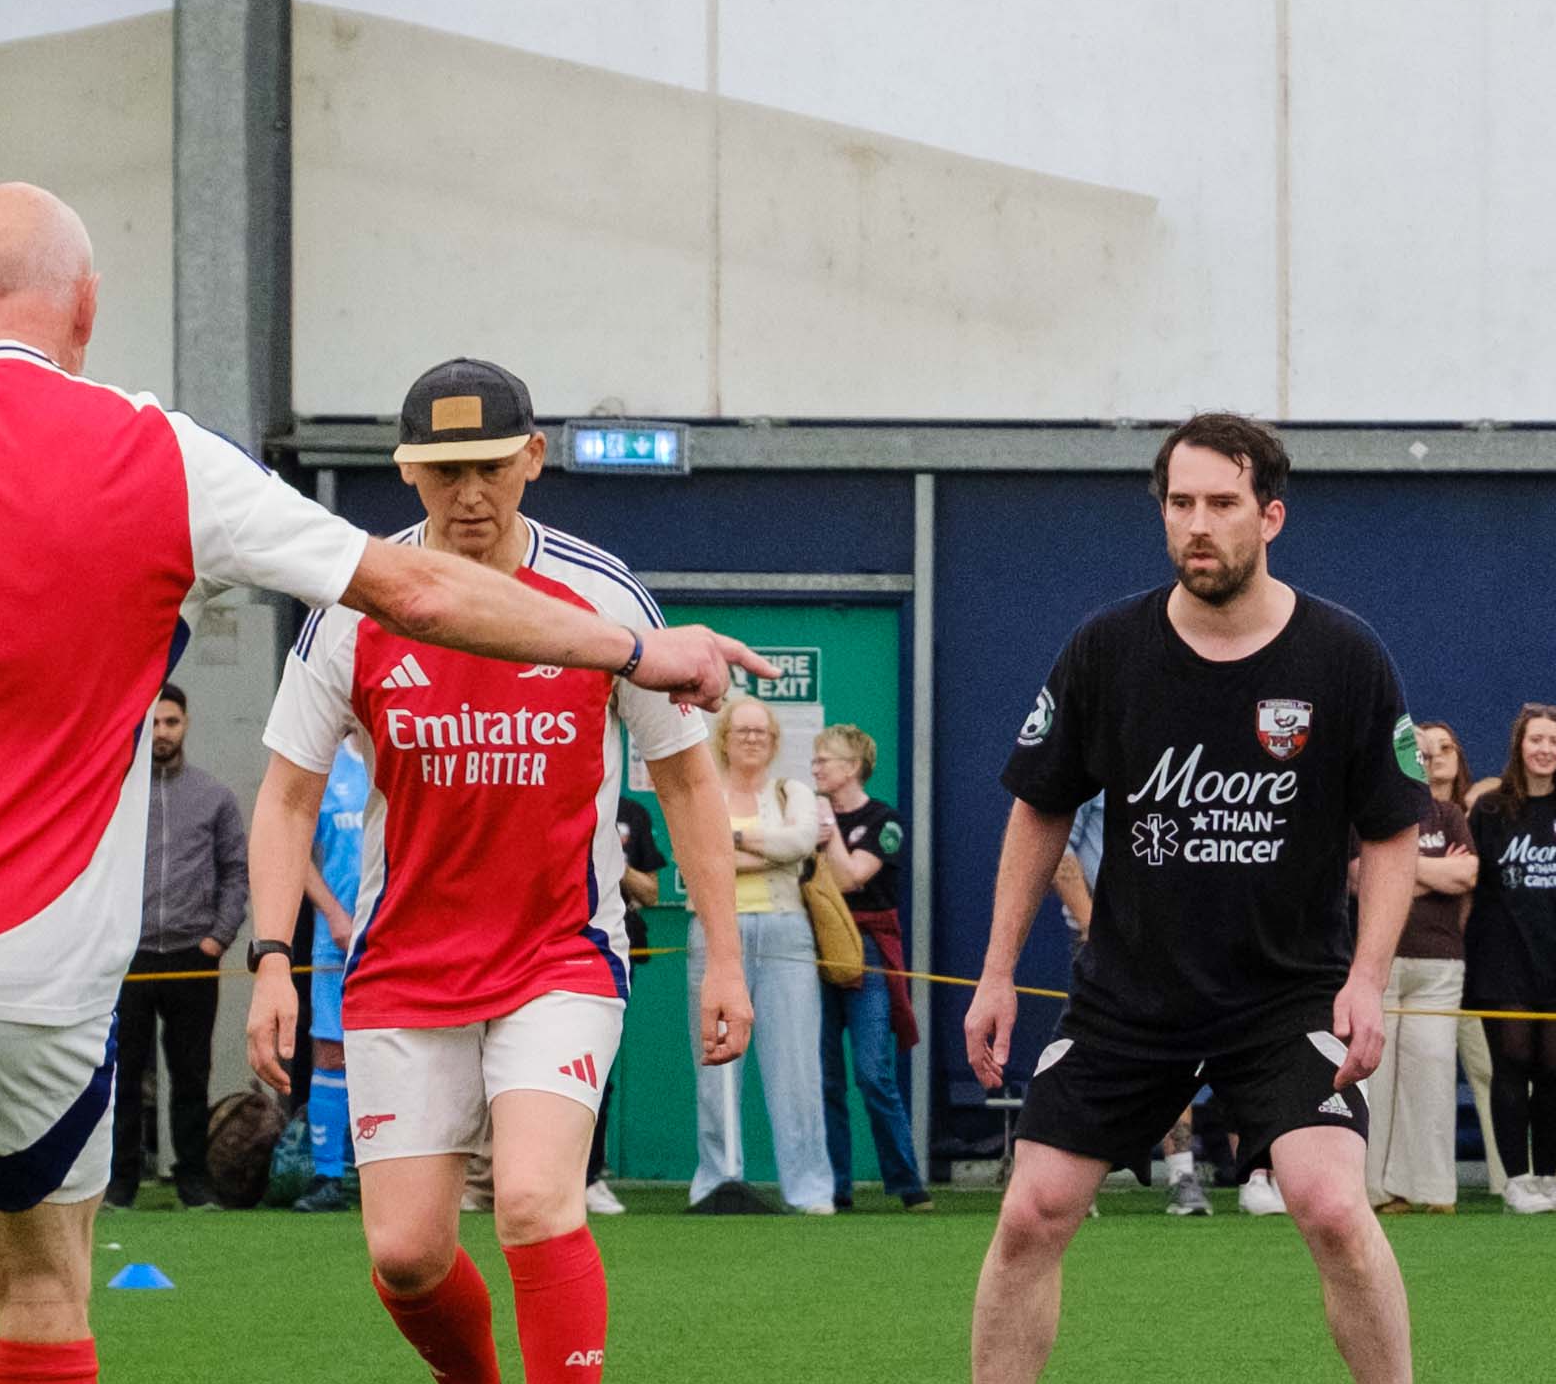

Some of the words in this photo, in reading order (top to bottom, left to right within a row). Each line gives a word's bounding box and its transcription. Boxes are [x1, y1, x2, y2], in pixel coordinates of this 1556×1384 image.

[757, 677, 811, 698] EXIT
[387, 703, 577, 750] Emirates
[421, 754, 457, 786] FLY
[466, 751, 547, 786] BETTER
[1127, 743, 1298, 808] Moore
[1182, 838, 1284, 864] cancer
[565, 1349, 604, 1367] AFC
